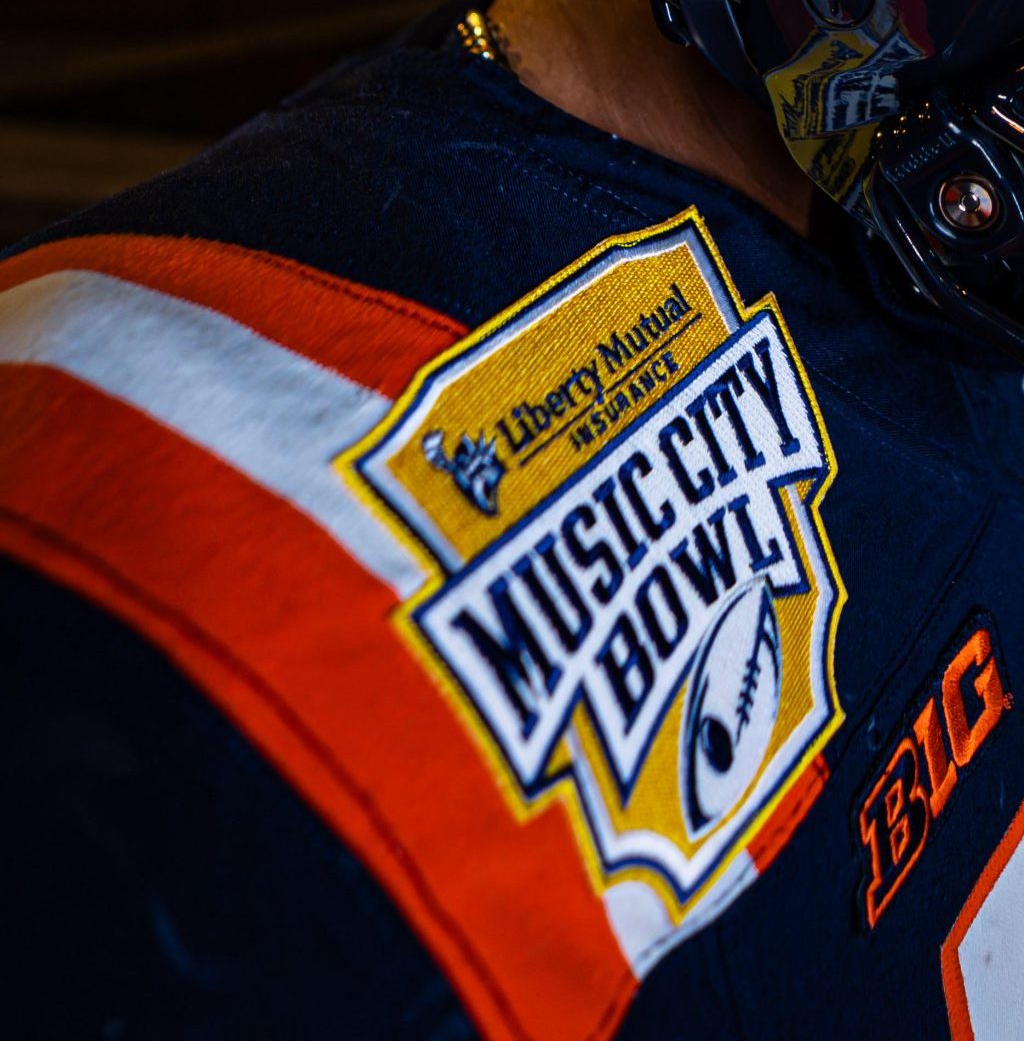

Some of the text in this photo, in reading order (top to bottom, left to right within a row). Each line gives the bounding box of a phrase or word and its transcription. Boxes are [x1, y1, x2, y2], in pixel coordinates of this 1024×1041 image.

[496, 283, 692, 452] Liberty Mutual
[570, 350, 681, 451] INSURANCE
[453, 336, 800, 740] MUSIC CITY
[596, 495, 782, 736] BOWL
